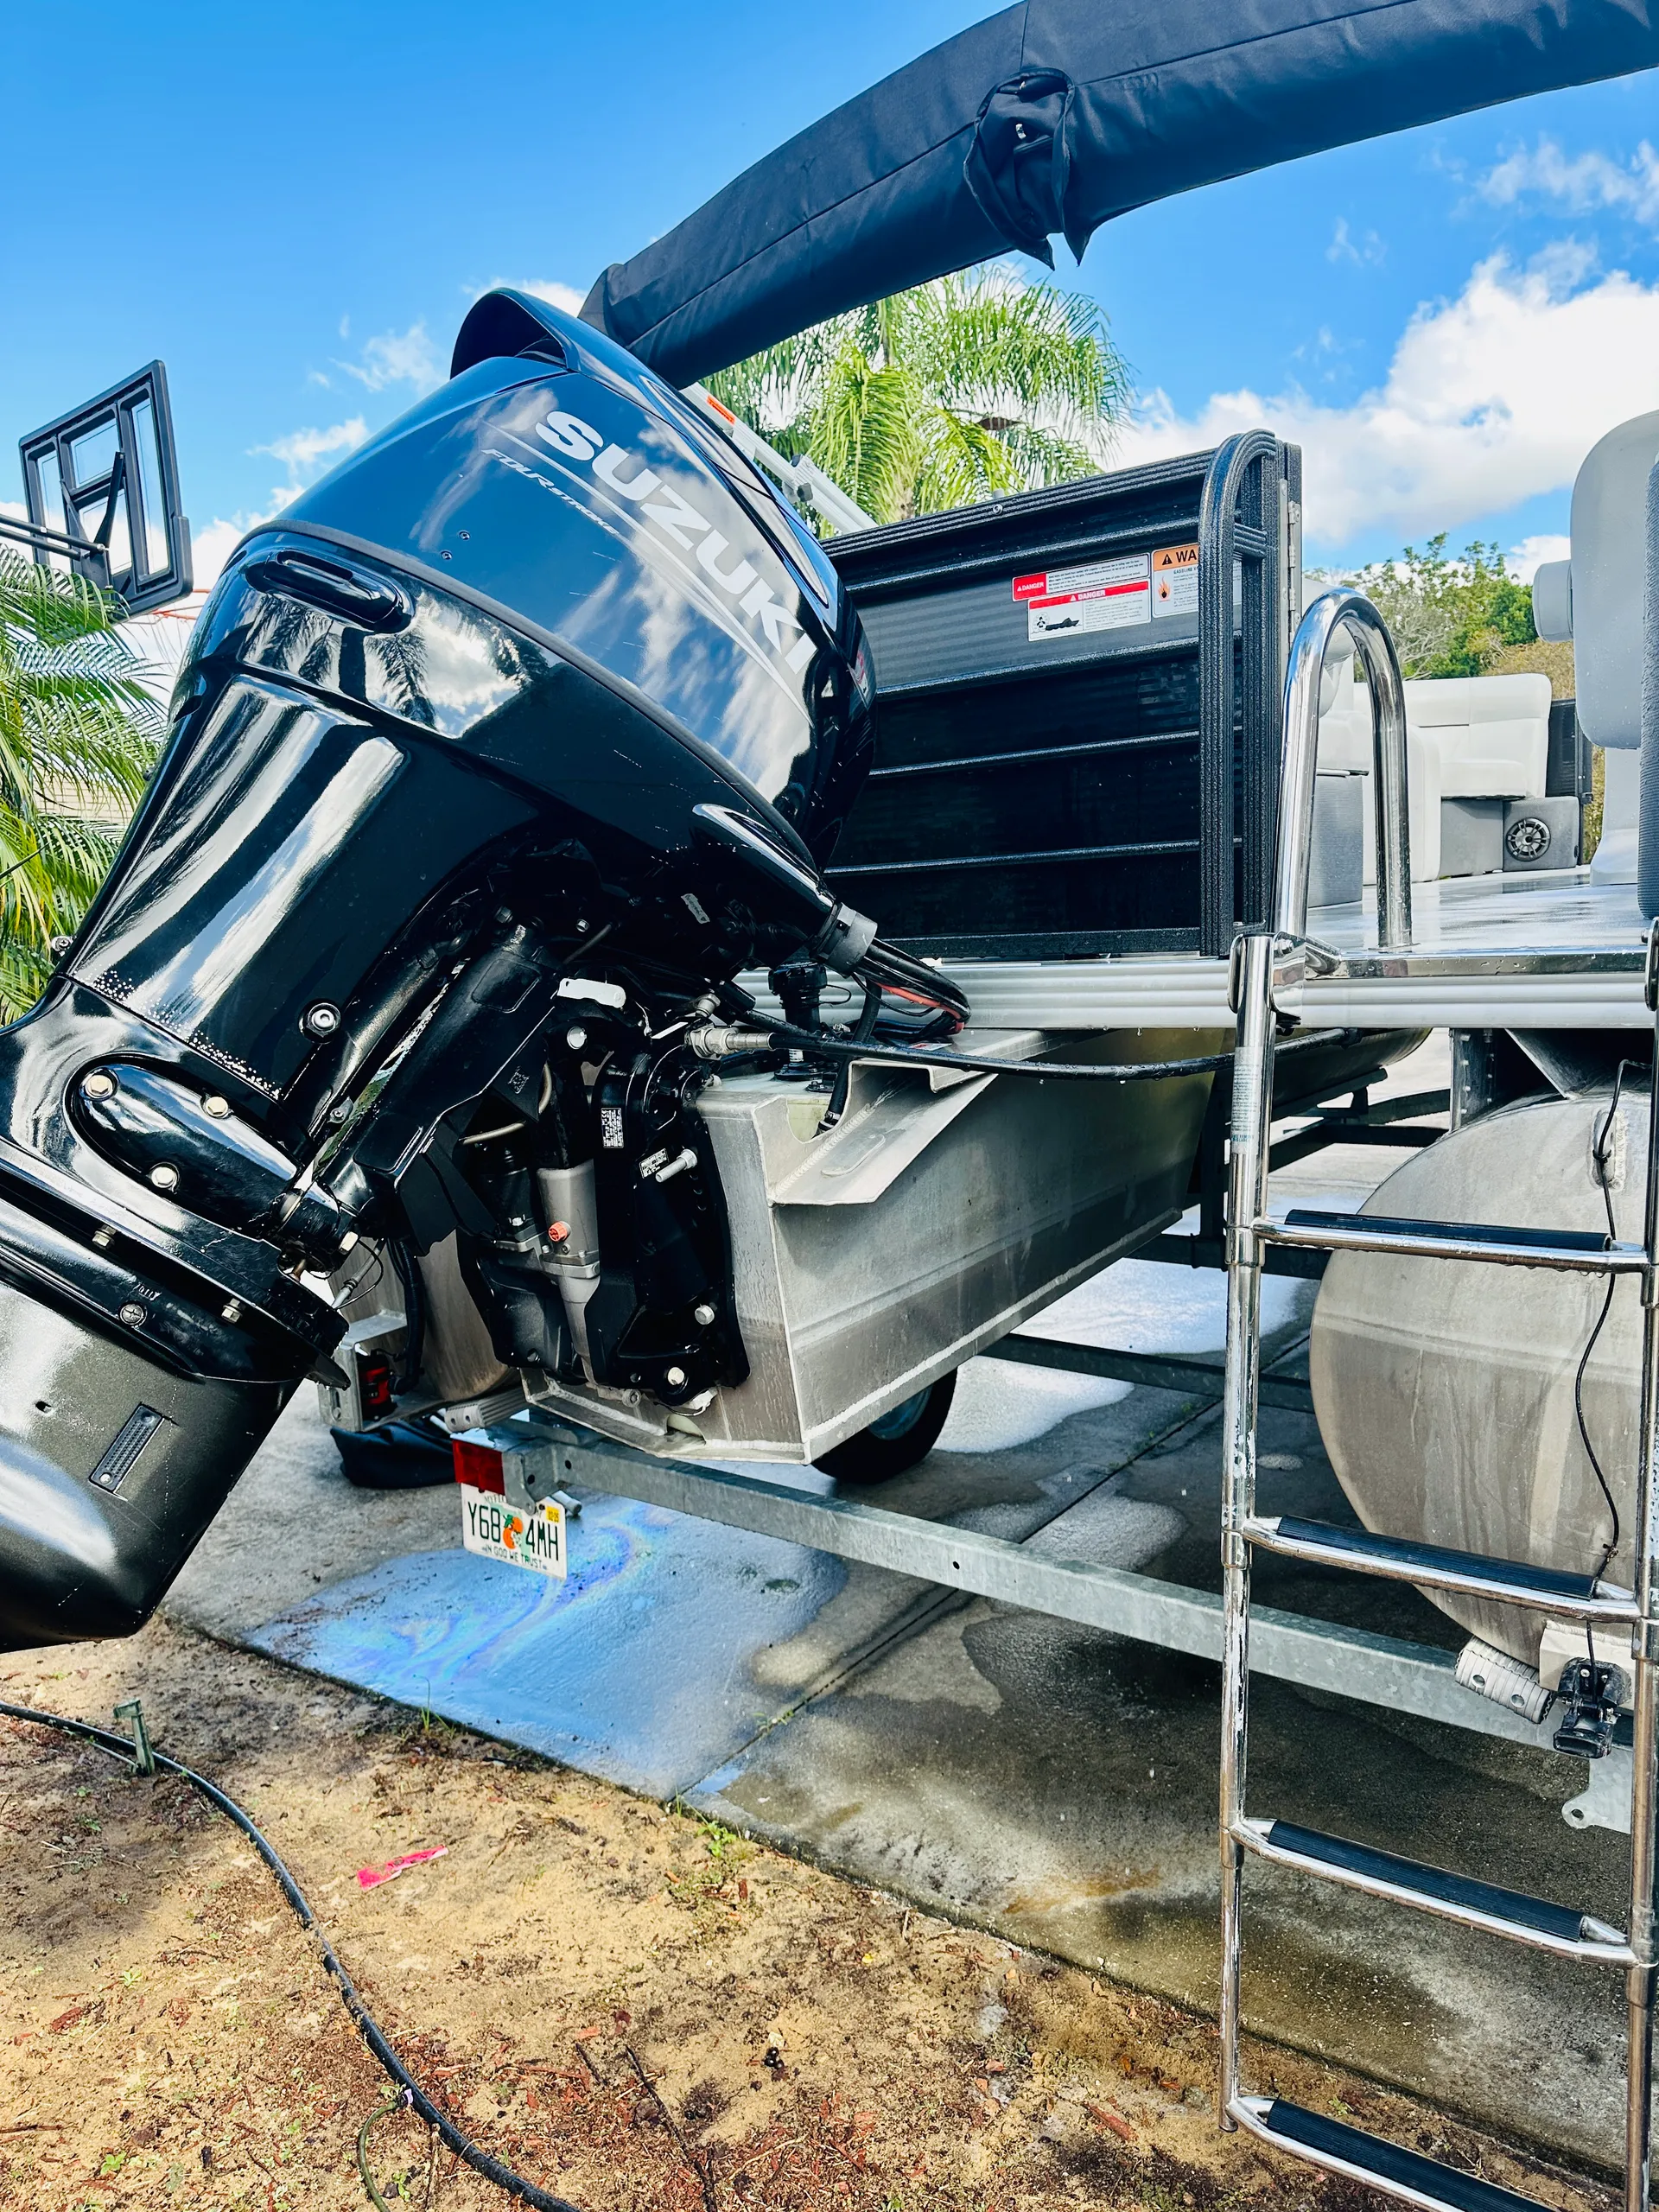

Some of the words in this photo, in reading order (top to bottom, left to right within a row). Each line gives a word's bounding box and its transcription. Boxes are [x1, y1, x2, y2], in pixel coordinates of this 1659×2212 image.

[536, 410, 817, 674] SUZUKI
[1021, 582, 1045, 591] DANGER
[1077, 589, 1106, 601] DANGER
[467, 1501, 501, 1543] Y68
[525, 1518, 559, 1561] 4MH
[493, 1546, 507, 1559] GOD
[509, 1550, 519, 1562] WE
[521, 1554, 542, 1568] TRUST
